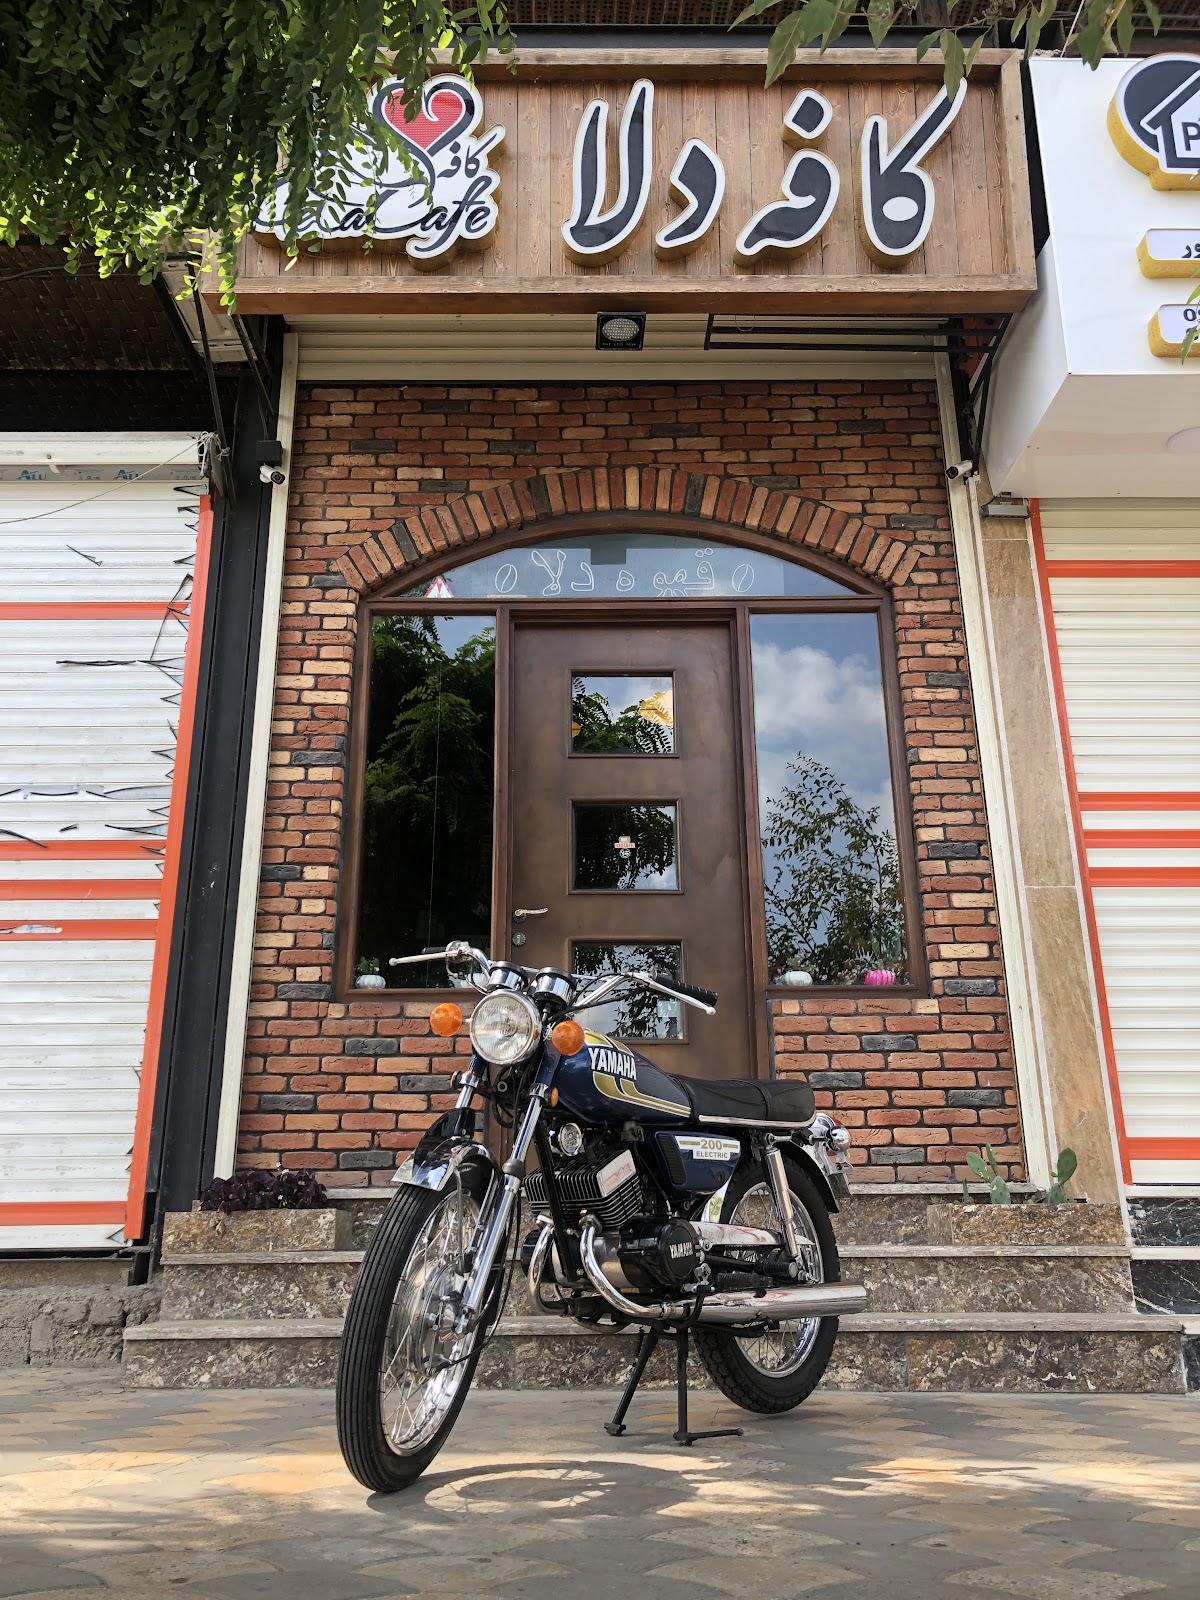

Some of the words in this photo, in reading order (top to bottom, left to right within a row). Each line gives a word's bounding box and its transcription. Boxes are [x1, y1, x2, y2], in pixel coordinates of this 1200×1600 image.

[569, 84, 718, 250] دلا
[531, 549, 595, 597] دلا
[587, 1047, 637, 1081] YAMAHA
[696, 1150, 728, 1159] ELECTRIC
[700, 1138, 723, 1151] 200
[669, 1241, 694, 1260] YAMAHA
